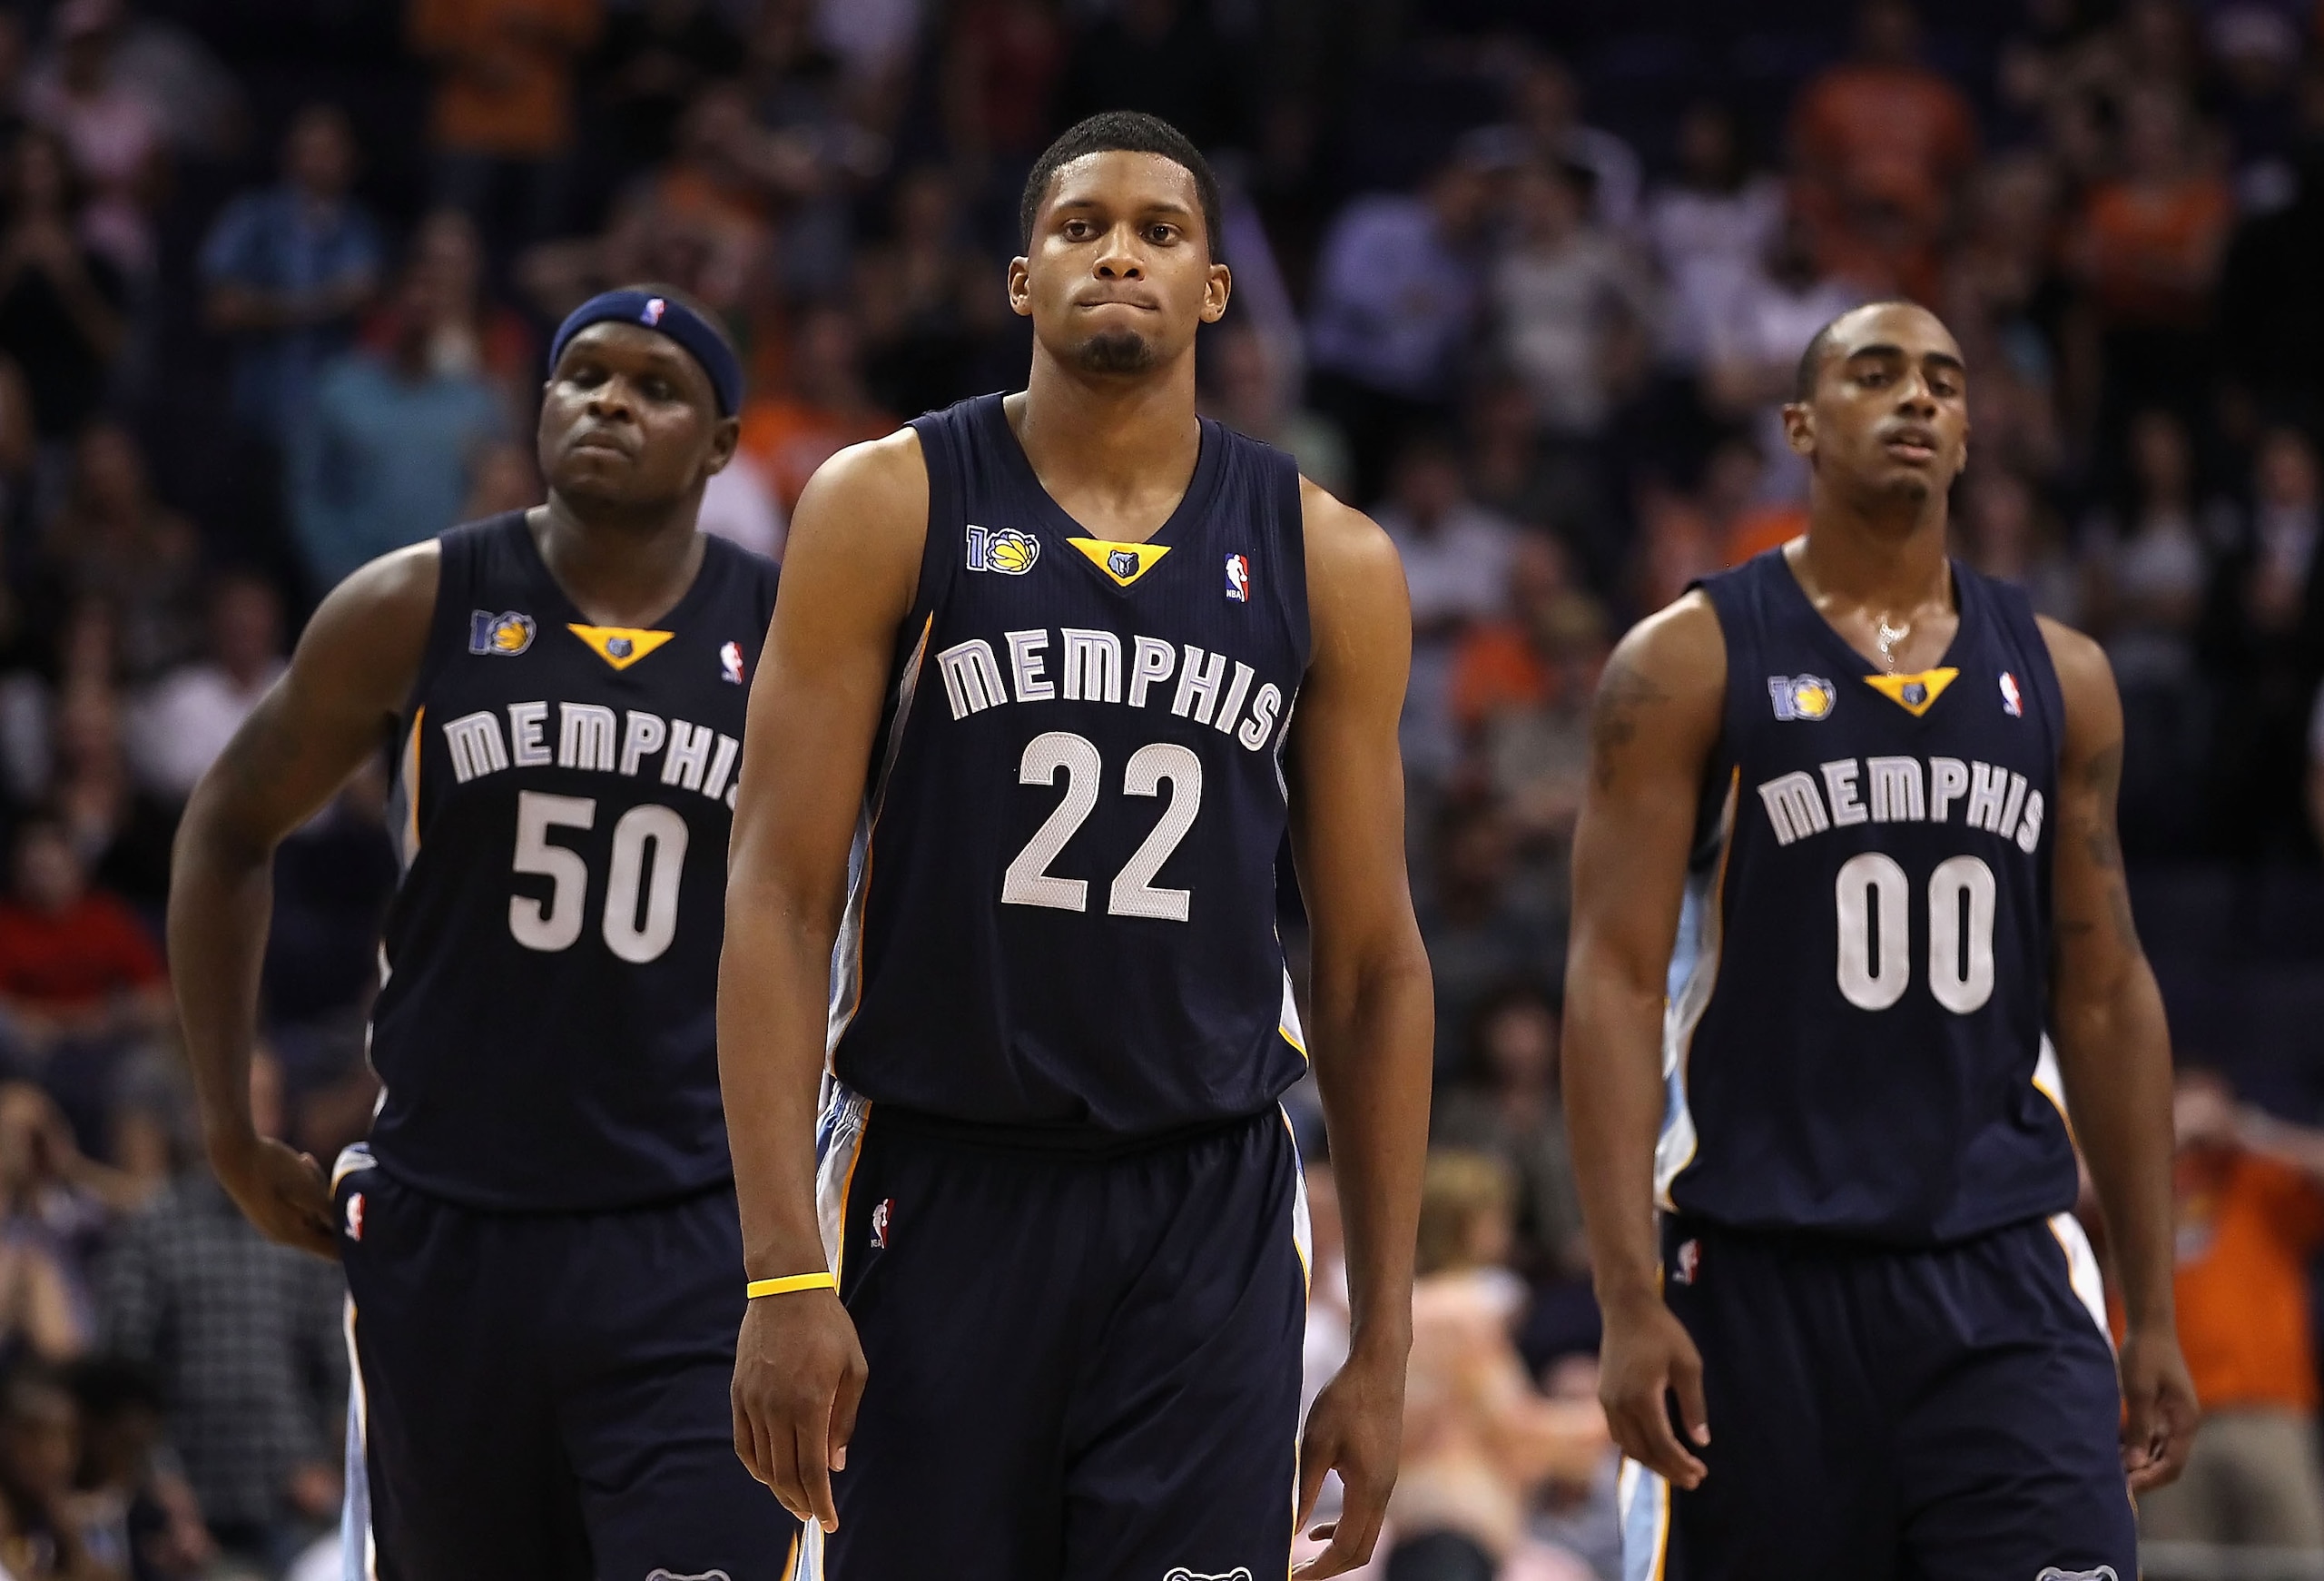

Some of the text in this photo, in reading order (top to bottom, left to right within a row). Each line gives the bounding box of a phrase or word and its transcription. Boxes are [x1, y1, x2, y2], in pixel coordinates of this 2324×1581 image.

[1226, 589, 1241, 599] NBA
[936, 627, 1281, 752] MEMPHIS
[443, 701, 739, 811] MEMPHI
[1758, 756, 2044, 854] MEMPHIS
[508, 789, 689, 963] 50
[1001, 731, 1202, 922] 22
[1836, 852, 1996, 1014] 00
